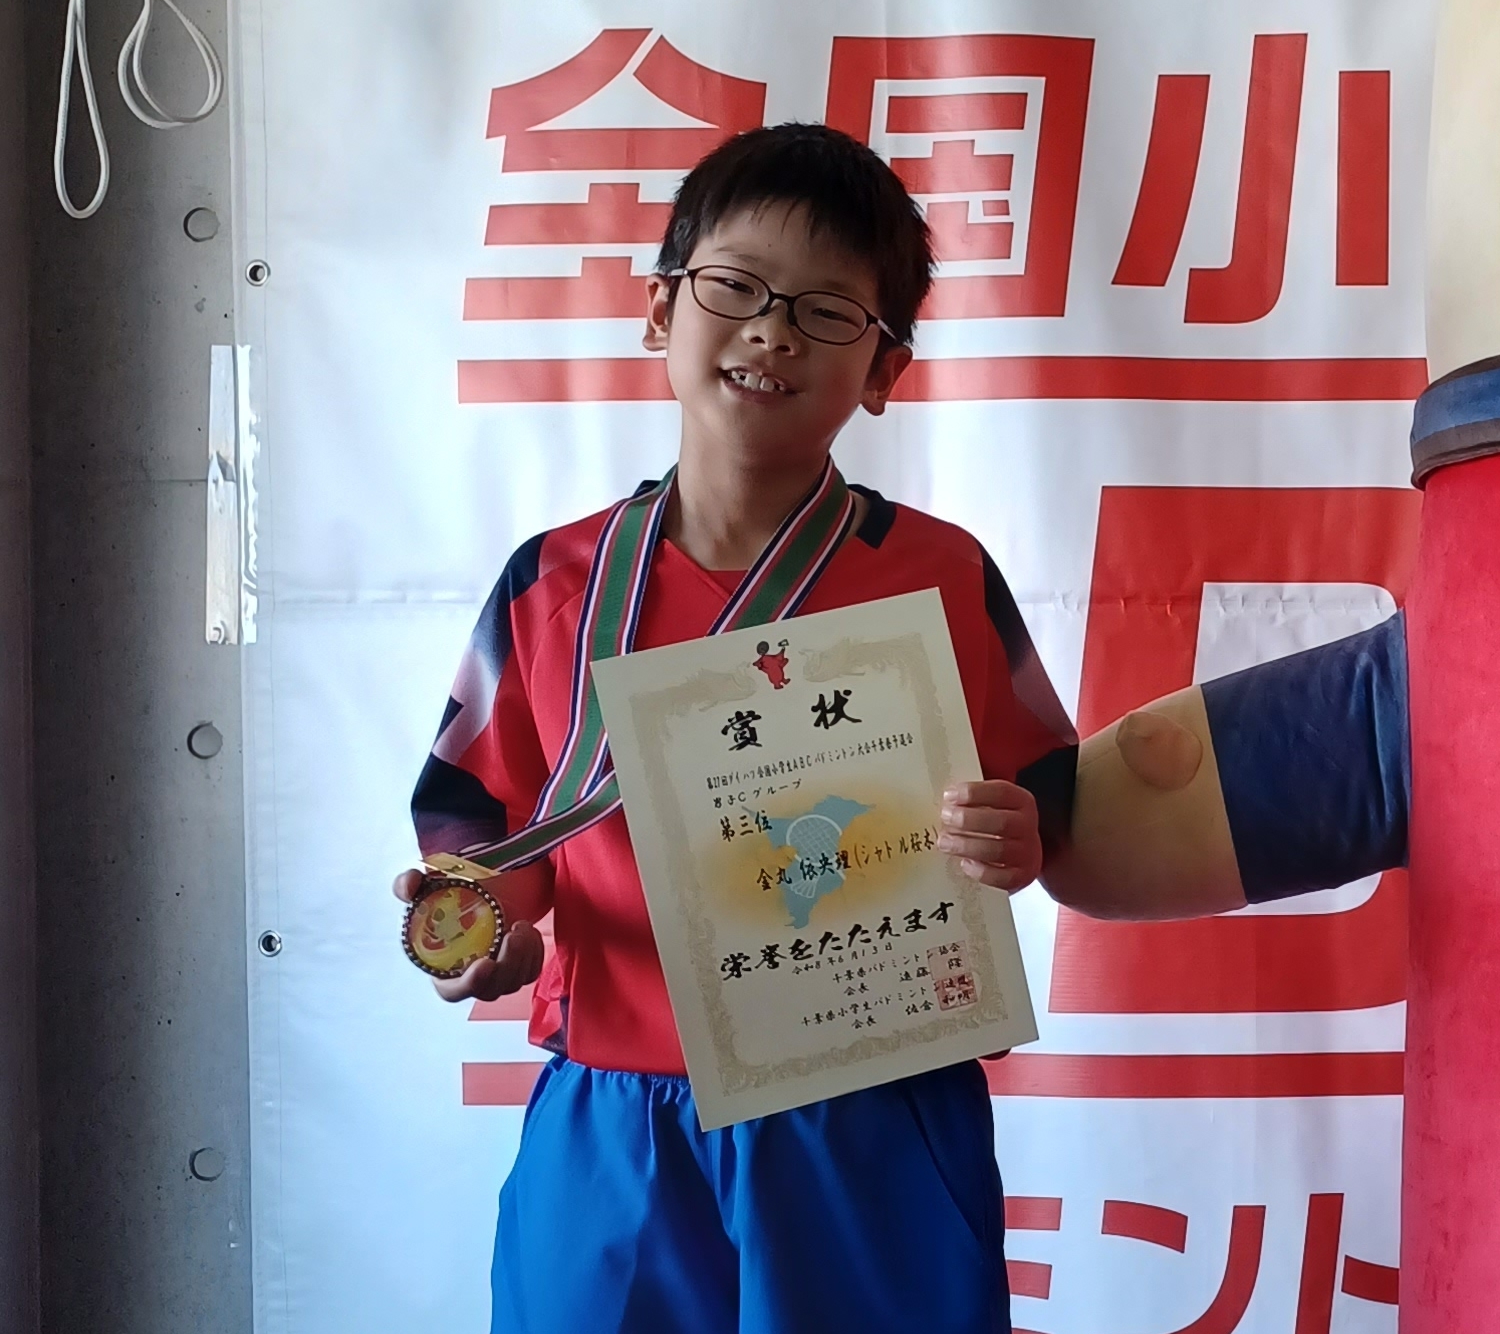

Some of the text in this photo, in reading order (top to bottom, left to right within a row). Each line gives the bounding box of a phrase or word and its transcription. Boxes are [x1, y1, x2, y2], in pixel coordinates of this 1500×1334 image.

[721, 689, 862, 751] 賞状
[720, 810, 772, 842] 第三位
[756, 866, 792, 891] 金丸
[720, 901, 955, 981] 栄誉をたたえます
[843, 983, 870, 997] 会長
[851, 1015, 877, 1030] 会長
